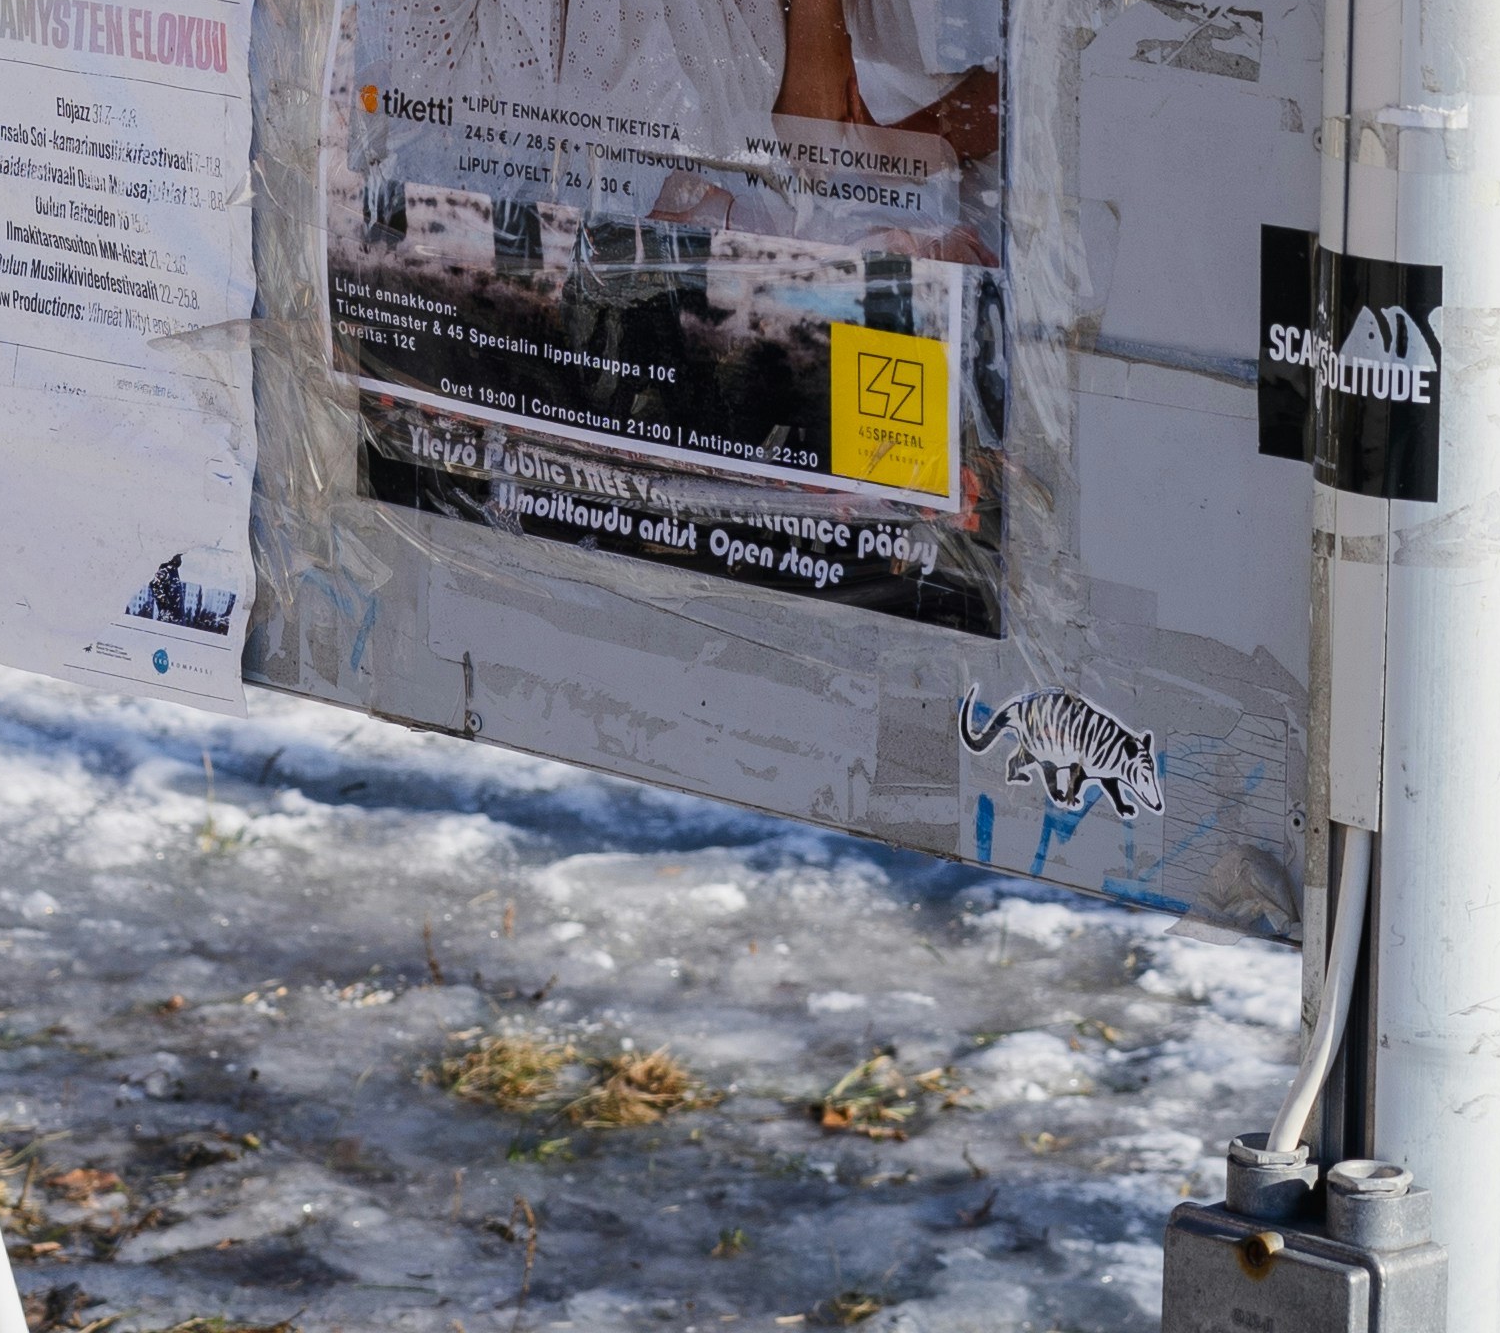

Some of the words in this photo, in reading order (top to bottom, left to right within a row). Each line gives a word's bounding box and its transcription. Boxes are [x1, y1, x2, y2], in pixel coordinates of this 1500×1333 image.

[128, 6, 229, 74] ELOKUU
[56, 96, 90, 123] Elojazz
[382, 88, 454, 126] tiketti
[512, 102, 602, 129] ENNAKKOON
[606, 116, 681, 142] TIKETISTÄ
[458, 155, 499, 176] LIPUT
[745, 133, 931, 180] WWW.PELTOKURKI.FI
[69, 199, 117, 229] Taiteiden
[6, 220, 98, 257] Ilmakitaransoiton
[99, 234, 149, 269] MM-kisat
[30, 259, 160, 303] Musiikkivideofestivaalit
[335, 278, 371, 300] Liput
[375, 287, 458, 317] ennakkoon:
[12, 290, 86, 321] Productions:
[336, 299, 428, 332] Ticketmaster
[469, 328, 538, 356] Specialin
[543, 344, 641, 377] lippukauppa
[338, 320, 389, 345] Ovelta:
[392, 333, 417, 351] 12€
[1319, 351, 1432, 404] SOLITUDE
[440, 378, 473, 399] Ovet
[479, 386, 516, 408] 19:00
[531, 399, 621, 432] Cornoctuan
[627, 419, 672, 441] 21:00
[688, 429, 766, 459] Antipope
[771, 446, 819, 469] 22:30
[407, 424, 477, 467] Yleisö
[857, 523, 938, 576] pääsy
[638, 516, 697, 551] artist
[709, 528, 774, 569] Open
[778, 545, 844, 589] stage
